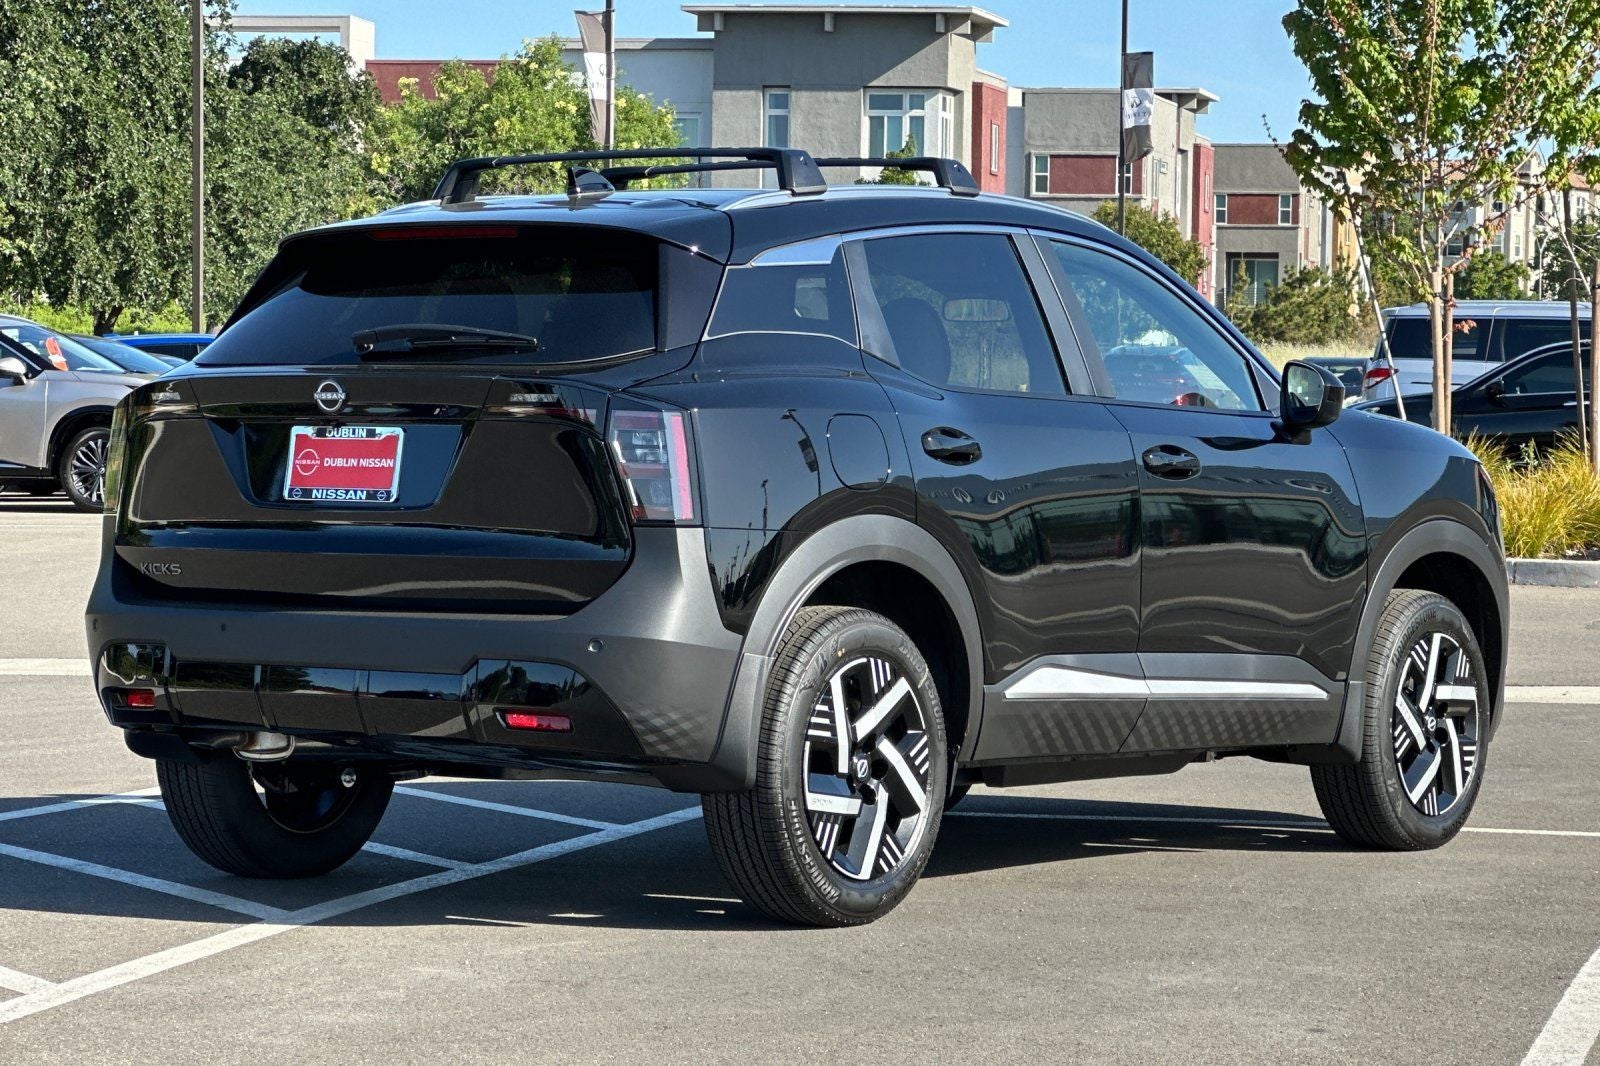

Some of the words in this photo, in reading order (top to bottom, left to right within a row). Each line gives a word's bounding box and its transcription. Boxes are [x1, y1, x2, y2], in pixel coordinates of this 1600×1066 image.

[314, 392, 345, 400] NISSAN
[326, 428, 367, 438] DUBLIN
[323, 457, 358, 467] DUBLIN
[359, 458, 394, 468] NISSAN
[311, 489, 367, 500] NISSAN
[140, 562, 182, 575] KICKS
[787, 800, 840, 904] BRIDGESTONE
